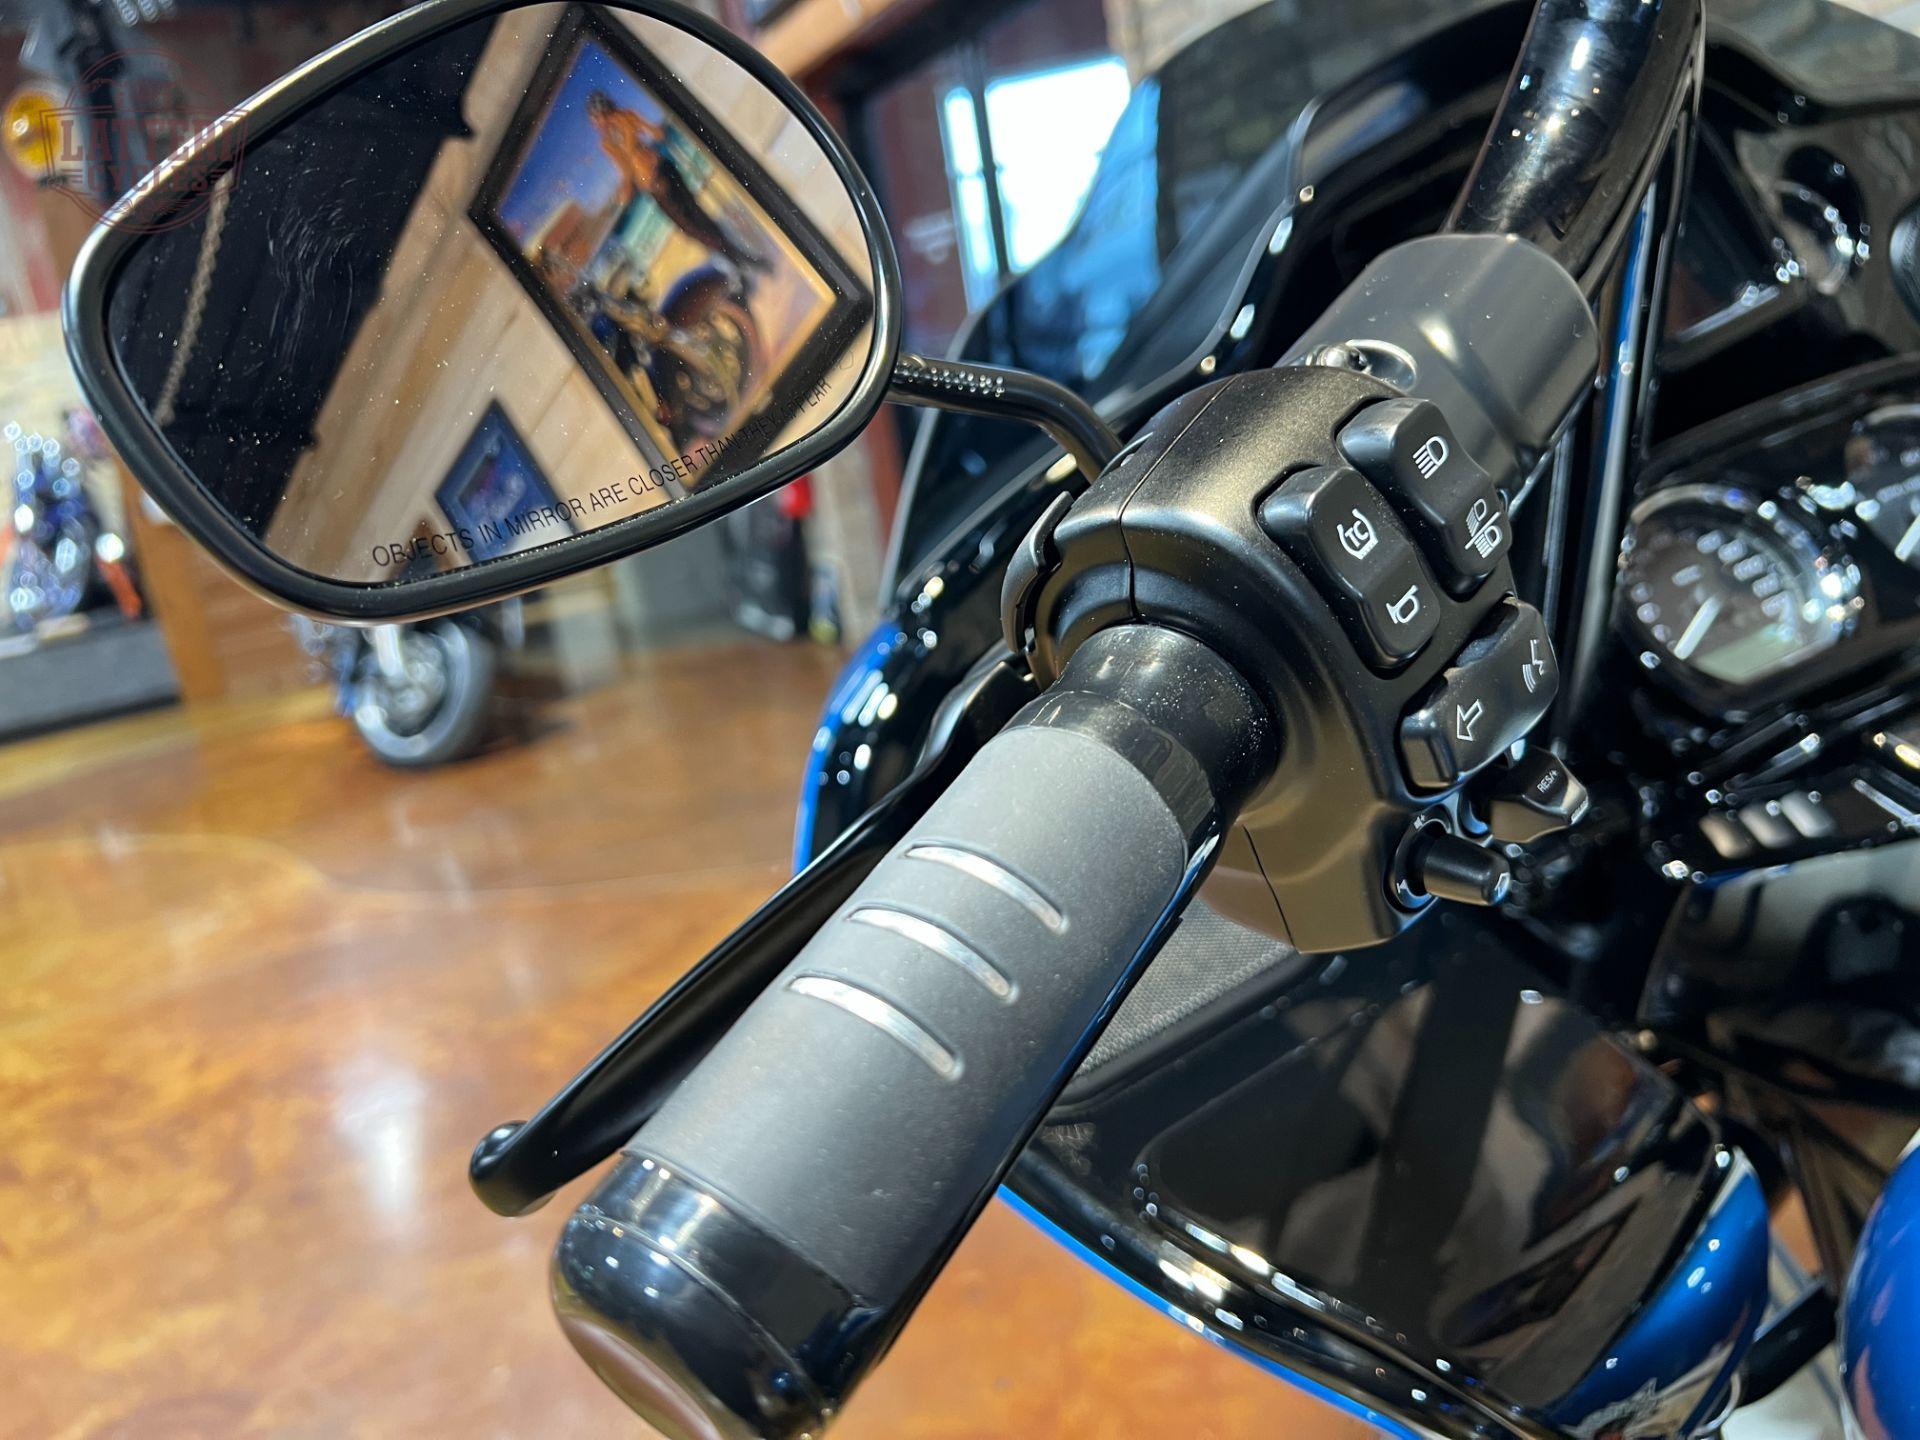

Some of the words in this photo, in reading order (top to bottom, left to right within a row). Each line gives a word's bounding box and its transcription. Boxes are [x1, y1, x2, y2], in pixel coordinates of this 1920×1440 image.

[371, 527, 475, 567] OBJECTS
[480, 520, 503, 544] IN
[504, 497, 587, 537] MIRROR
[589, 482, 629, 513] ARE
[627, 454, 698, 497] CLOSER
[695, 431, 744, 467] THAN
[1344, 520, 1369, 549] TC
